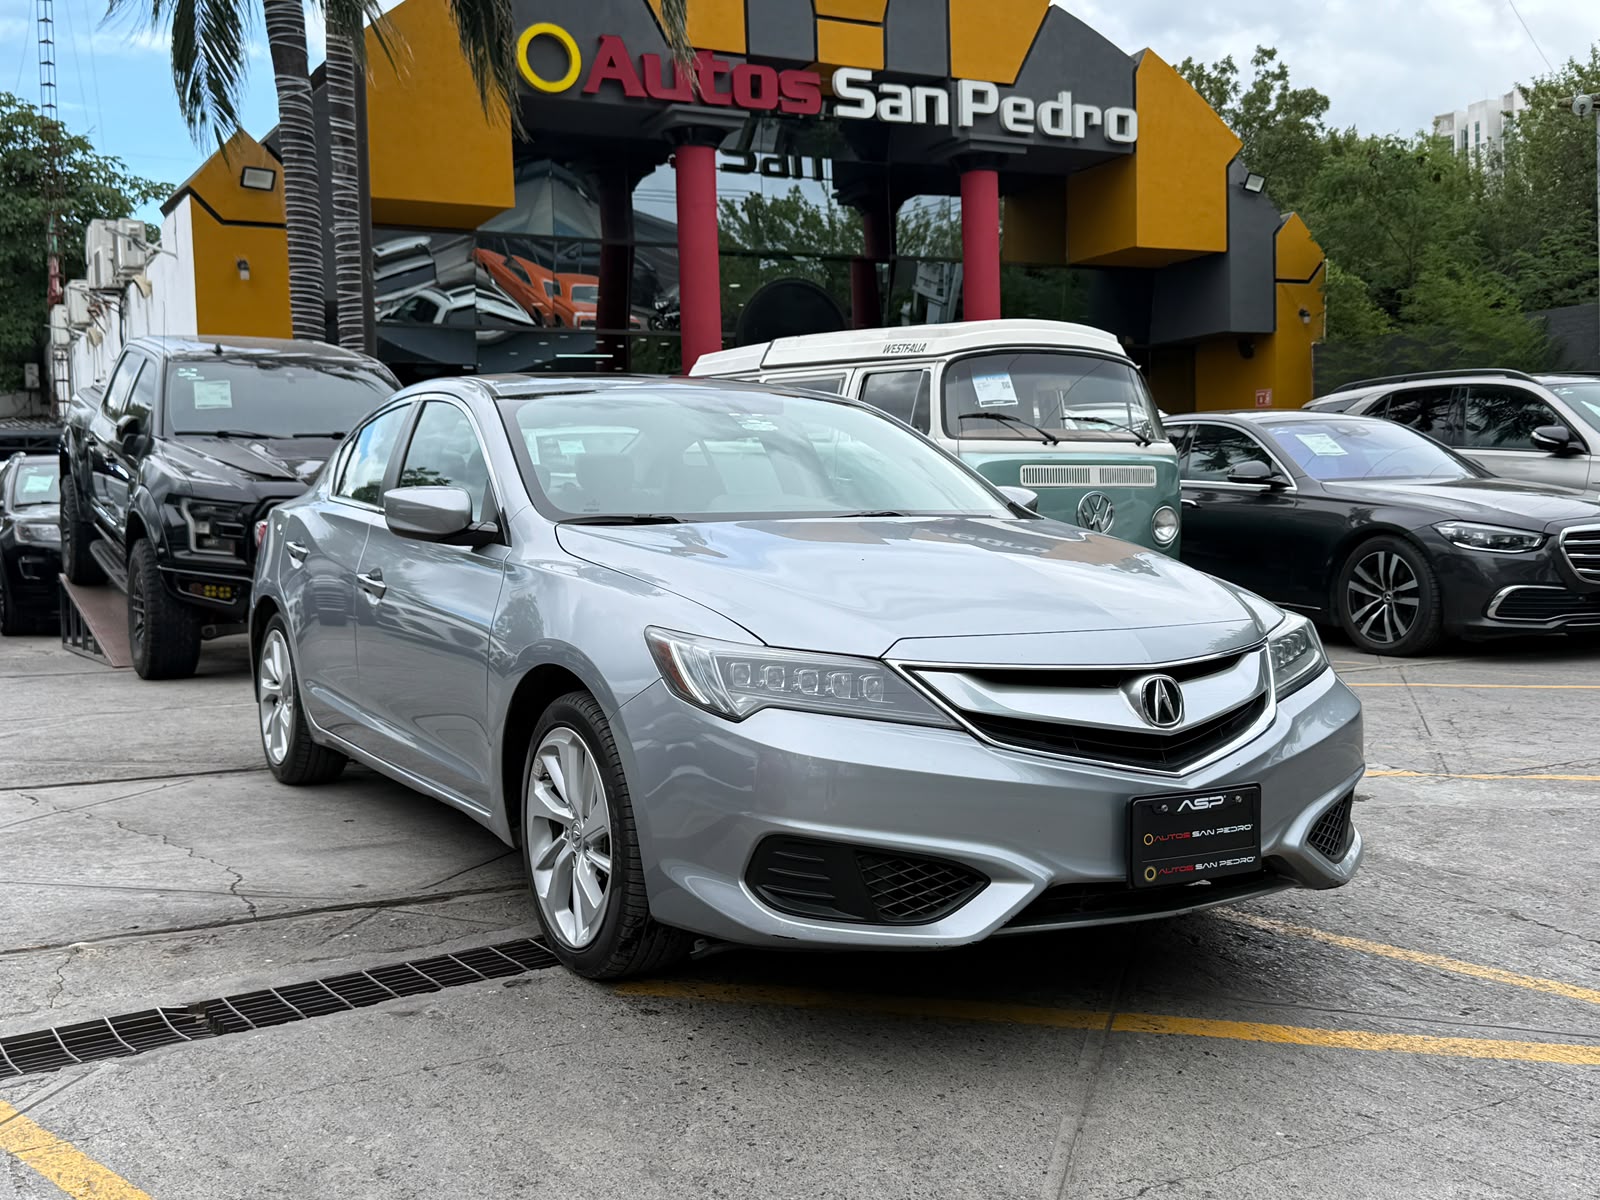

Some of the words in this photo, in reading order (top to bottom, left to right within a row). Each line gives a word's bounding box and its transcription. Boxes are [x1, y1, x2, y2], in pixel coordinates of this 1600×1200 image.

[583, 35, 821, 115] Autos
[832, 67, 949, 126] San
[958, 80, 1138, 144] Pedro
[883, 343, 927, 354] WESTFALIA
[1177, 795, 1225, 812] ASP
[1153, 832, 1191, 843] AUTOS
[1192, 829, 1215, 838] SAN
[1216, 824, 1252, 834] PEDRO
[1158, 865, 1194, 875] AUTOS
[1195, 861, 1218, 870] SAN
[1219, 856, 1254, 866] PEDRO
